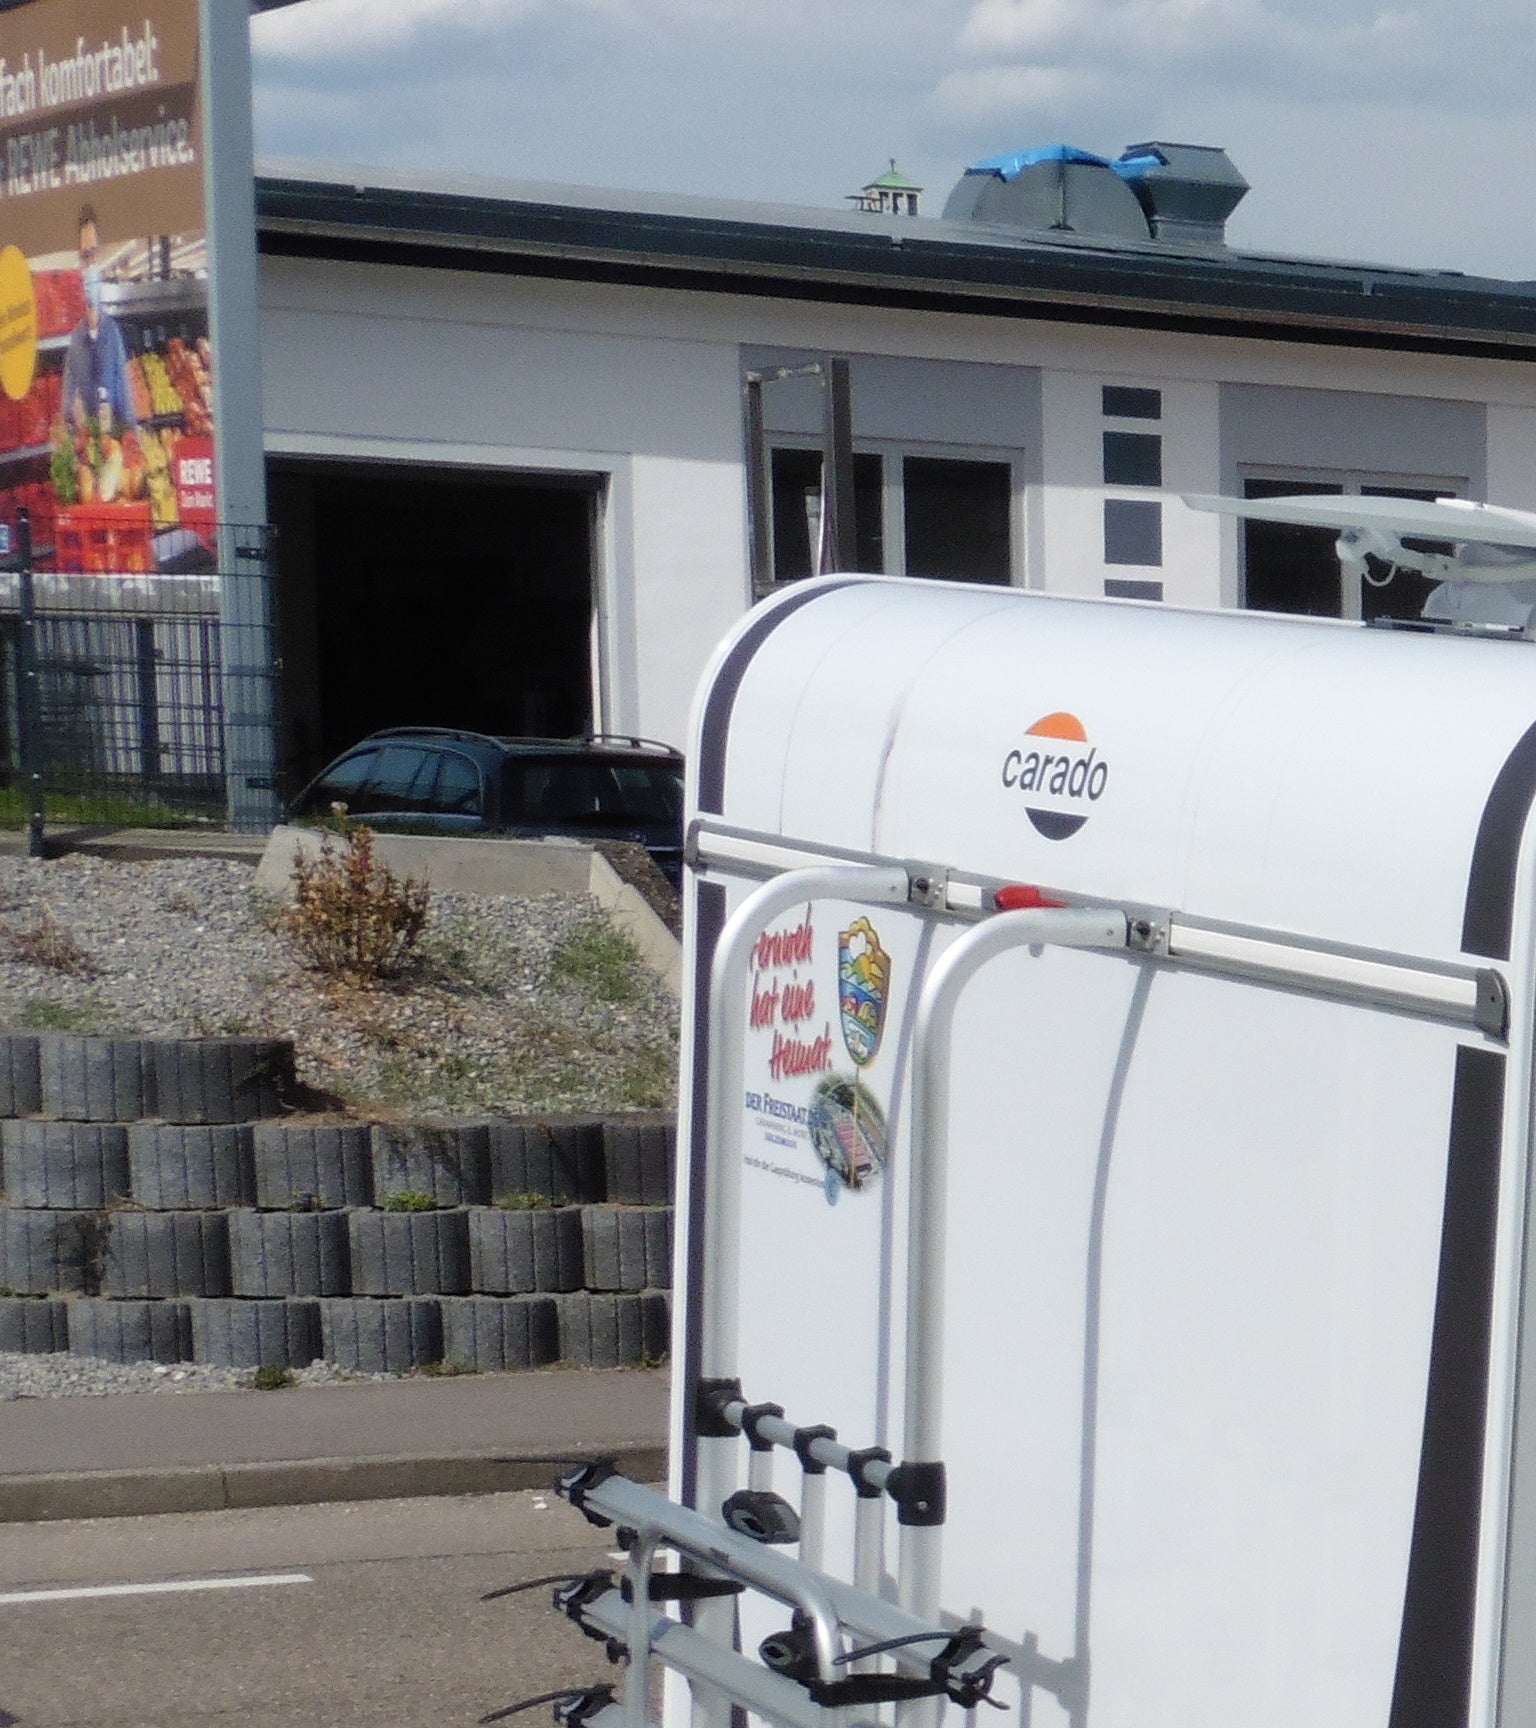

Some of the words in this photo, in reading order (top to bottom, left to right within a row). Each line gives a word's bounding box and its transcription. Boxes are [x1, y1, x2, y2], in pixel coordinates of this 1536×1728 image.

[40, 19, 159, 107] komfortabel:
[8, 127, 61, 194] REWE
[1001, 747, 1108, 801] carado
